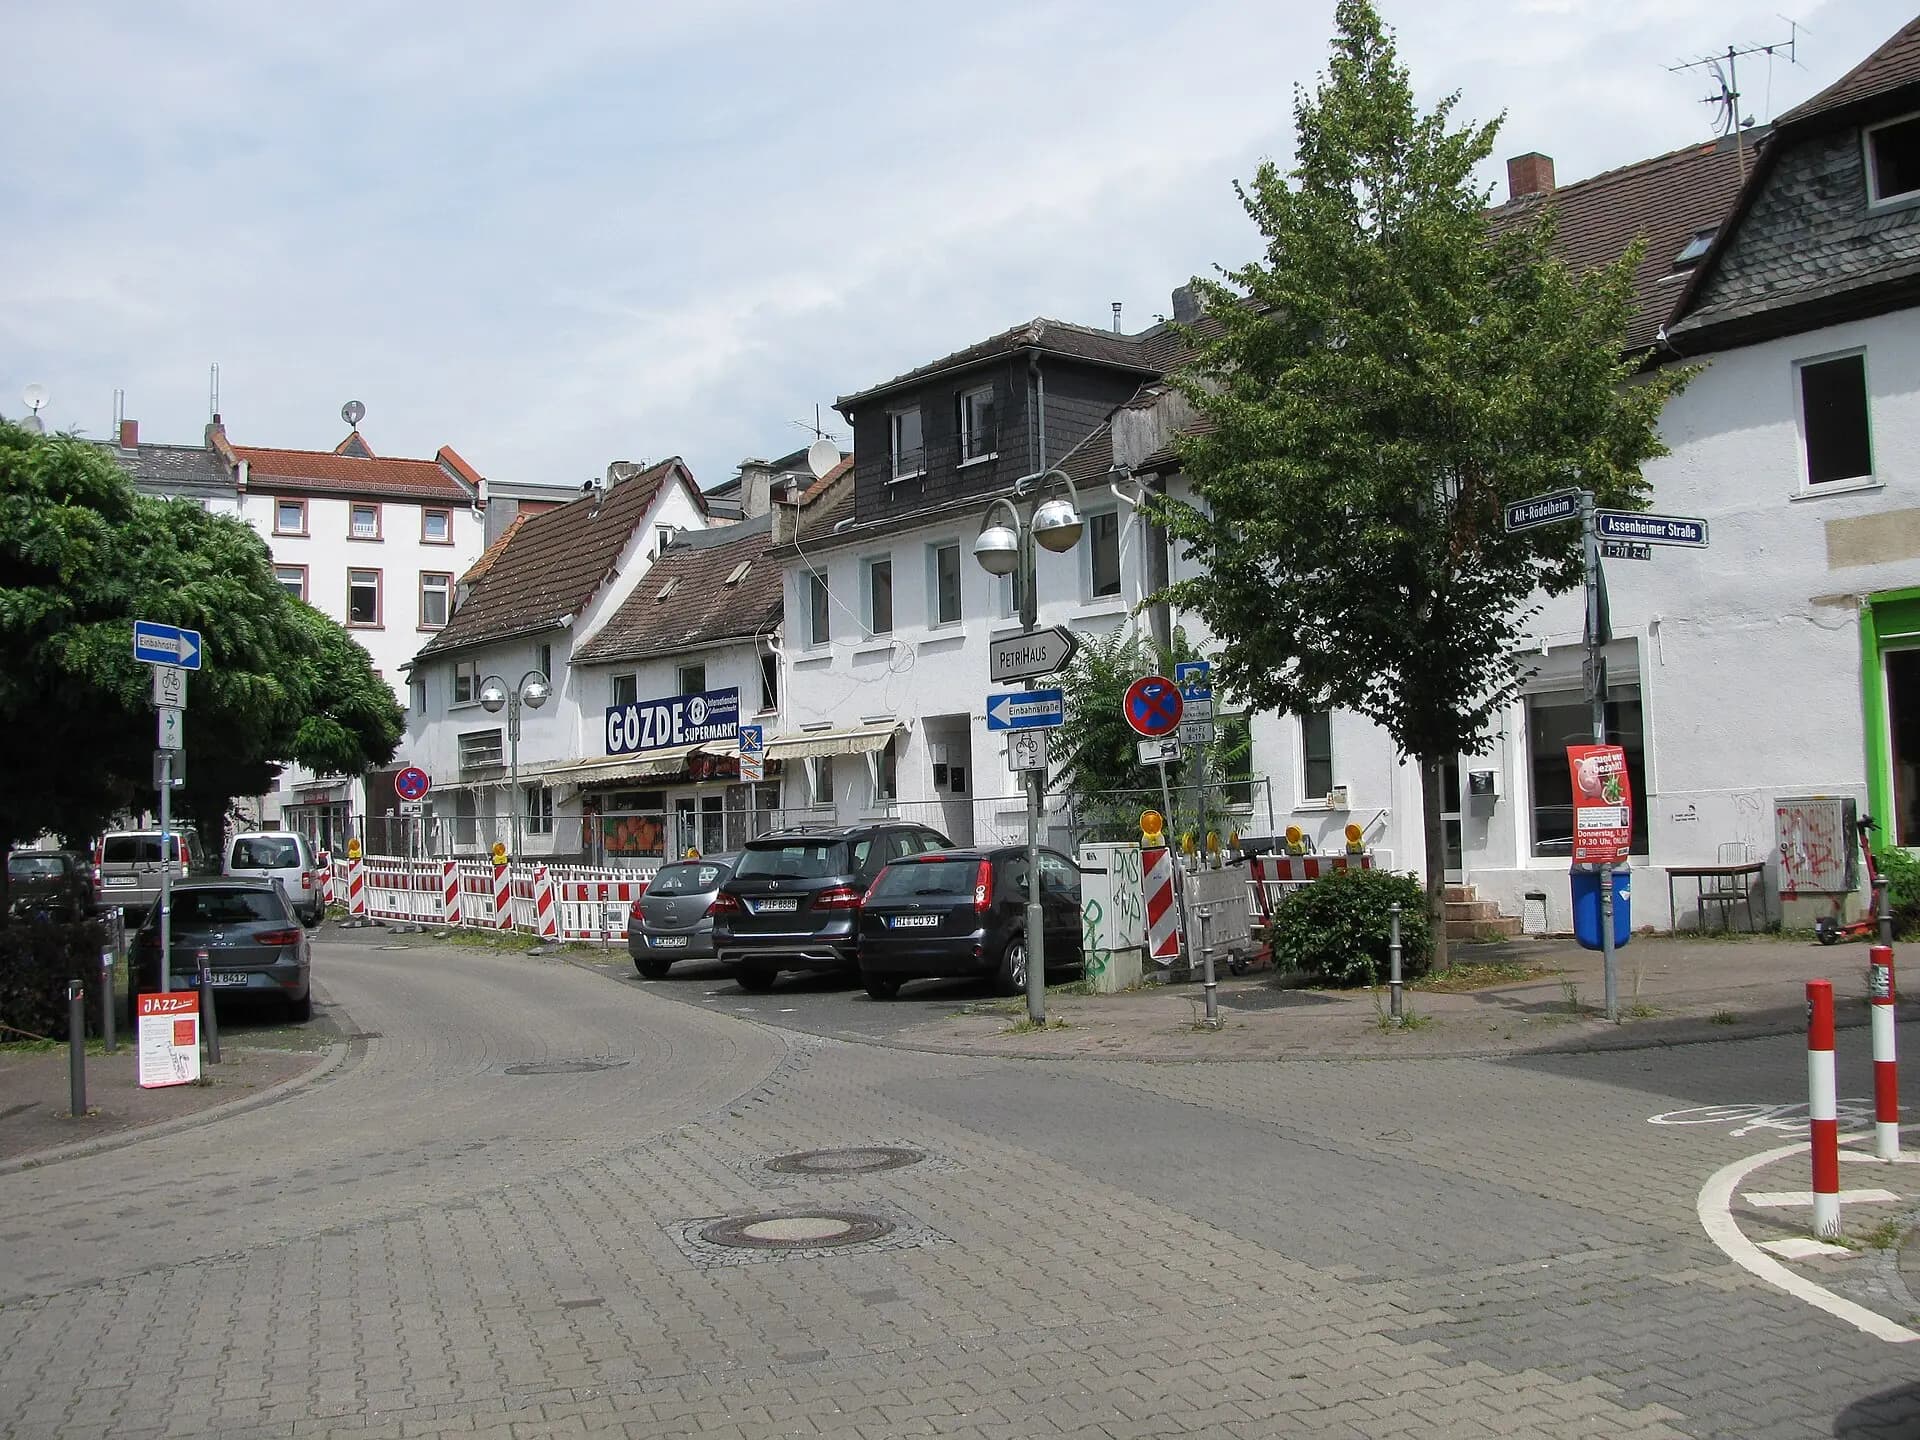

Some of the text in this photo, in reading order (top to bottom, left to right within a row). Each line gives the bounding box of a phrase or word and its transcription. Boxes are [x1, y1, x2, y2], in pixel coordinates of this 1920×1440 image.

[1514, 499, 1570, 523] Alt-Rödelheim
[1608, 518, 1696, 538] Assenheimer Straße
[1008, 704, 1059, 716] Einbahnstraße
[608, 703, 684, 752] GÖZDE
[684, 722, 738, 742] SUPERMARKT
[1578, 830, 1615, 838] Donnerstag,
[1578, 837, 1598, 846] 19.30
[896, 915, 936, 926] HI CO 93
[222, 973, 247, 983] 8412
[144, 998, 178, 1013] JAZZ
